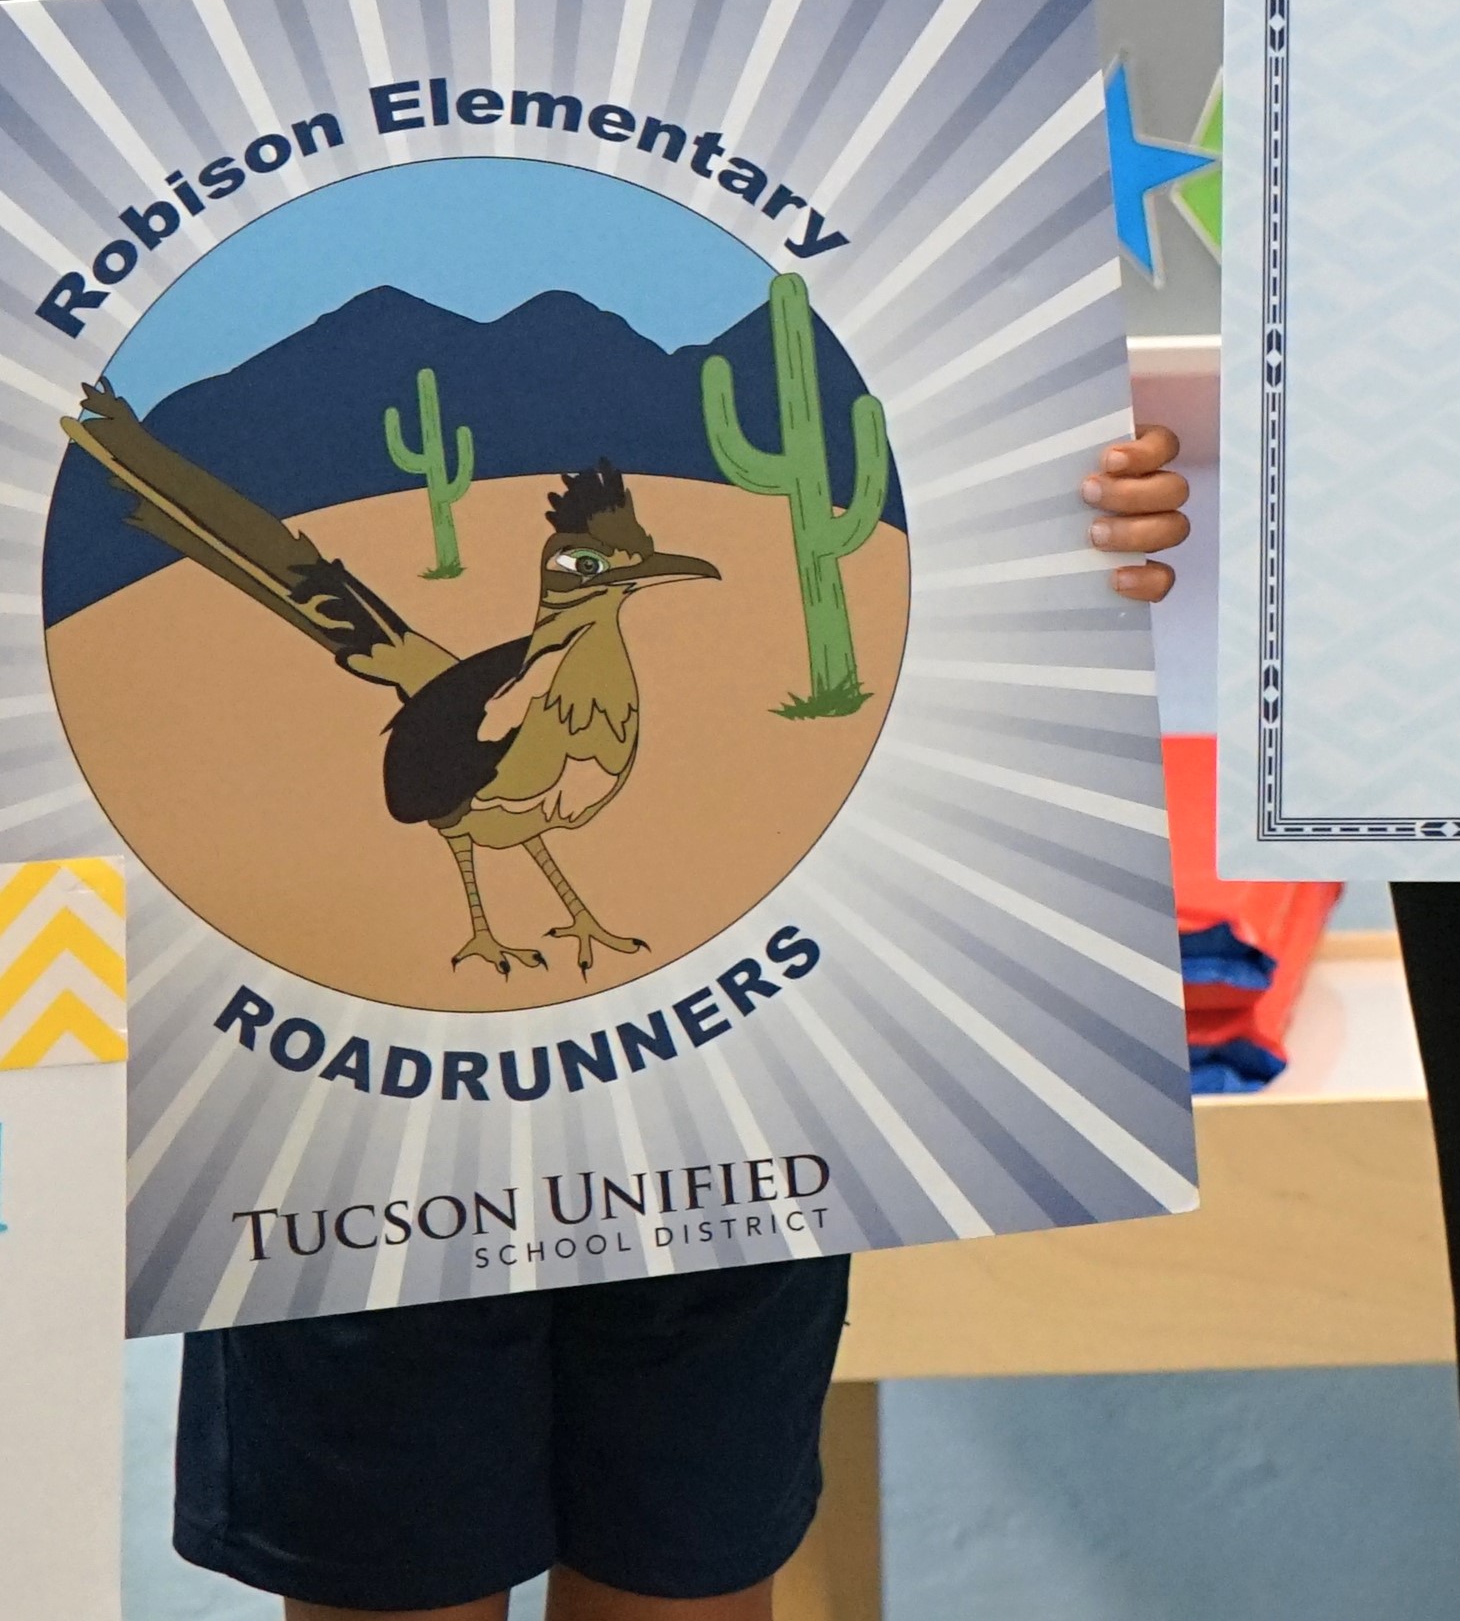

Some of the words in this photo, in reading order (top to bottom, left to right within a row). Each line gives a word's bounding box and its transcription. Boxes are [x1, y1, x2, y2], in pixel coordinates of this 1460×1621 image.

[34, 110, 347, 340] Robison
[367, 76, 852, 262] Elementary
[212, 922, 824, 1102] ROADRUNNERS
[473, 1237, 633, 1270] SCHOOL
[655, 1207, 832, 1249] DISTRICT
